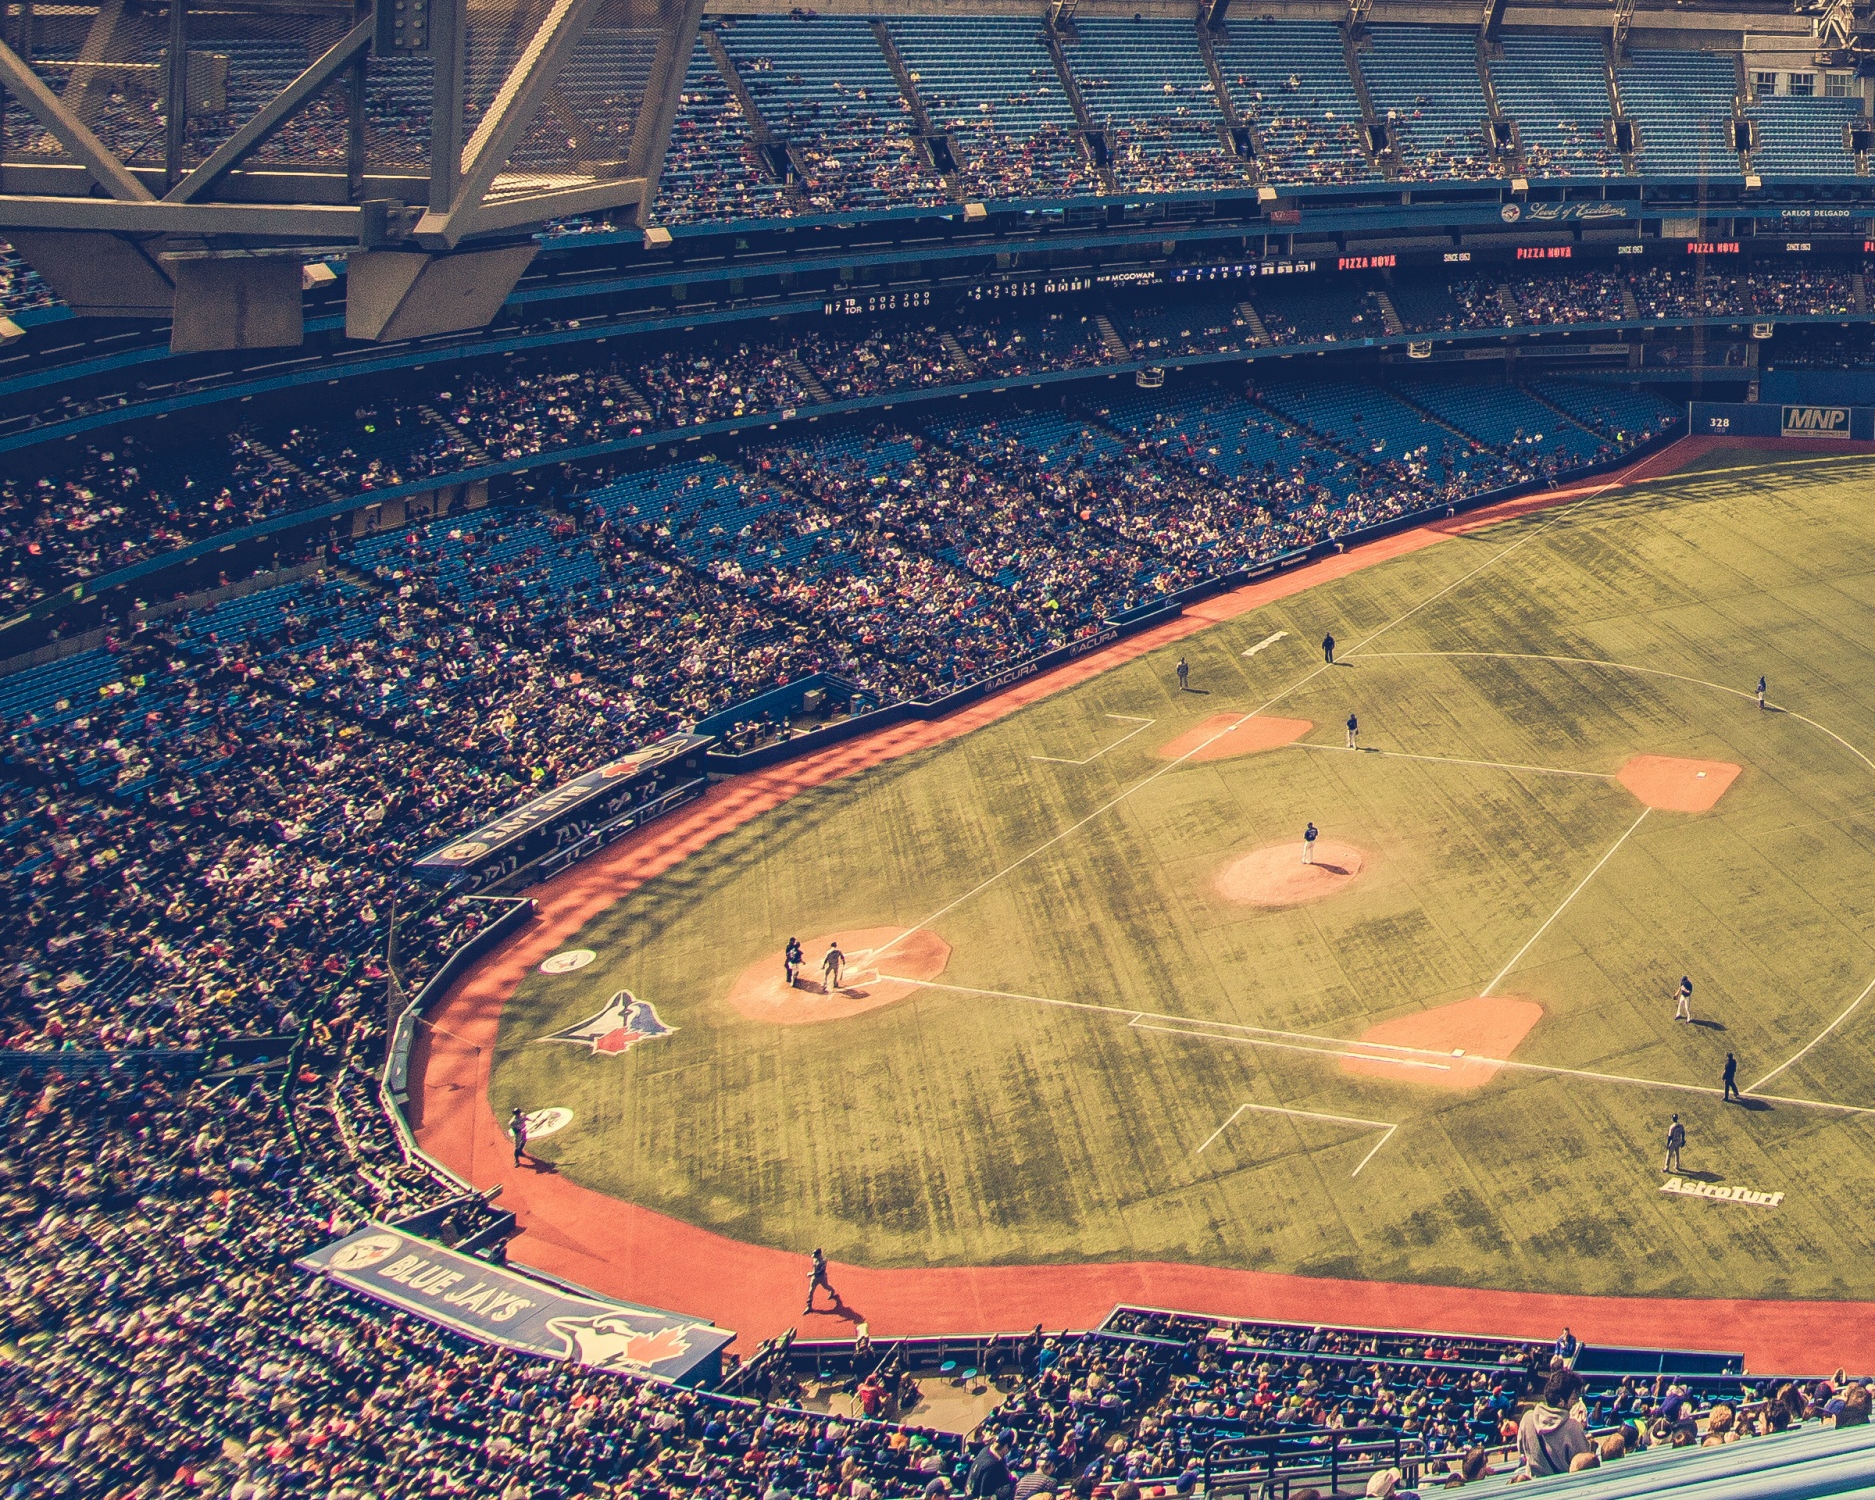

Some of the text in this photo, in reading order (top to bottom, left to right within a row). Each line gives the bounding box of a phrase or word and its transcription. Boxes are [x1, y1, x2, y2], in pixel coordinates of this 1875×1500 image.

[1525, 202, 1560, 219] Level
[1561, 205, 1573, 218] of
[1517, 246, 1572, 260] PIZZA NOVA
[1687, 242, 1740, 254] PIZZA NOVA
[1338, 255, 1396, 270] PIZZA NOVA
[1111, 271, 1155, 282] MCGOWAN
[924, 291, 930, 299] 0
[835, 304, 841, 312] 7
[845, 306, 862, 315] TOR
[924, 298, 929, 306] 0
[1709, 417, 1730, 428] 328
[1788, 408, 1845, 429] MNP
[1077, 630, 1118, 653] ACURA
[994, 663, 1038, 689] ACURA
[1659, 1177, 1786, 1207] AstroTurf
[377, 1253, 533, 1322] BLUE JAYS
